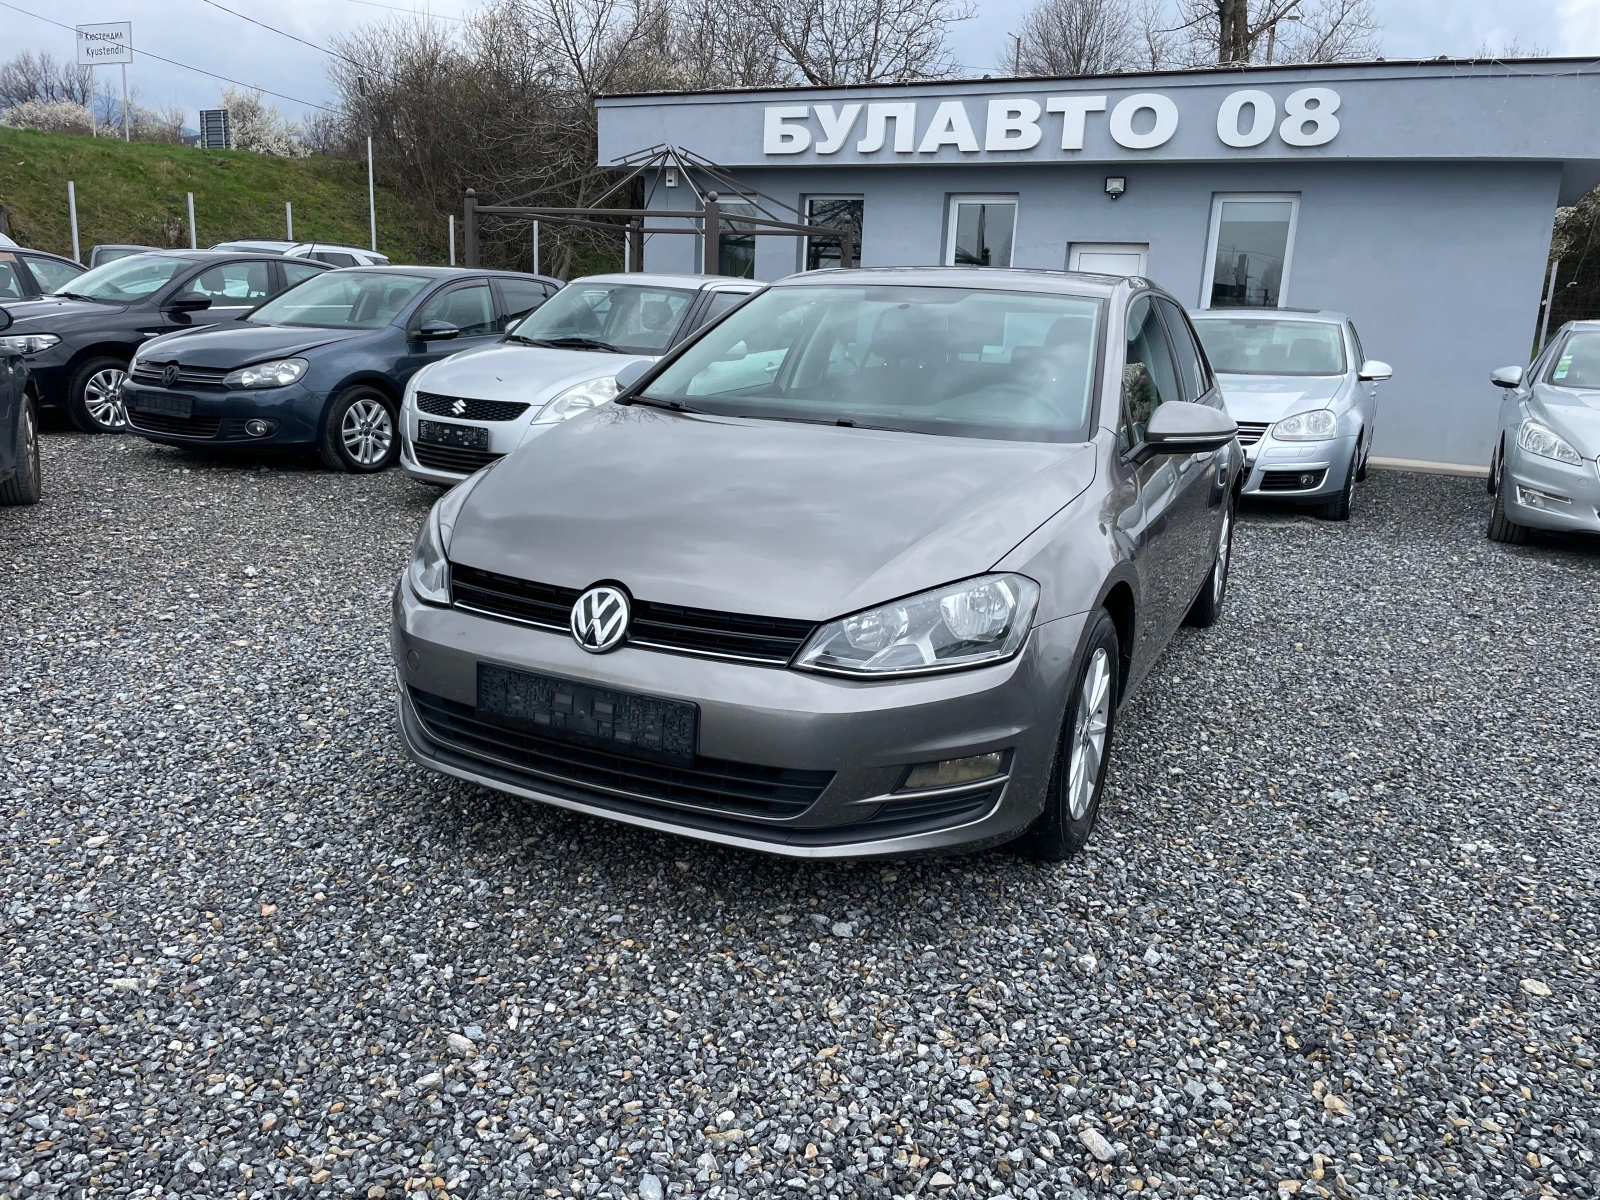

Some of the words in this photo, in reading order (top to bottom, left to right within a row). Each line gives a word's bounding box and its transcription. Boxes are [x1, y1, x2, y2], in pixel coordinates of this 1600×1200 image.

[86, 45, 124, 58] Kyustendil
[763, 93, 1179, 155] БУЛАВТО
[1216, 87, 1341, 149] 08
